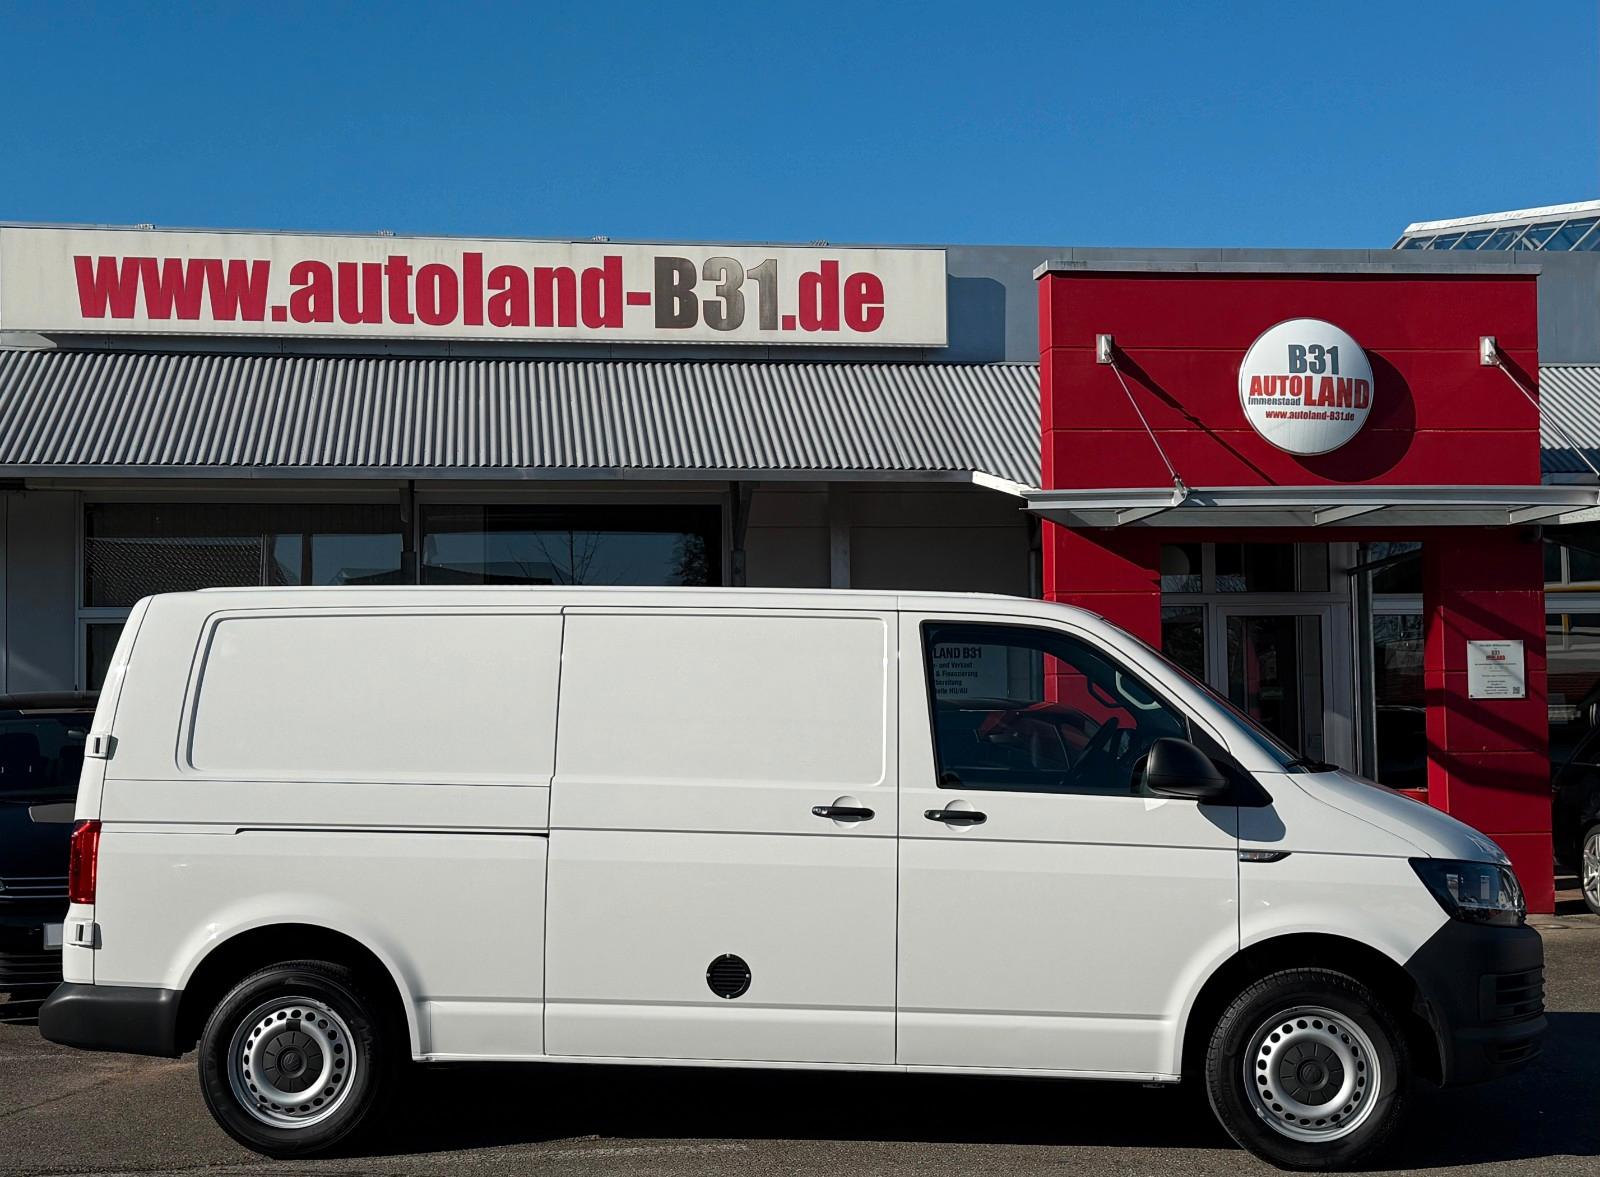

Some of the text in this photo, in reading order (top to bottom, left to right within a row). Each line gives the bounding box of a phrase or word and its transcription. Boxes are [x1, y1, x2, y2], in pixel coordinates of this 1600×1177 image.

[73, 251, 885, 332] www.autoland-B31.de
[1288, 344, 1339, 375] B31
[1265, 410, 1355, 421] www.autoland-B31.de
[963, 647, 982, 658] B31
